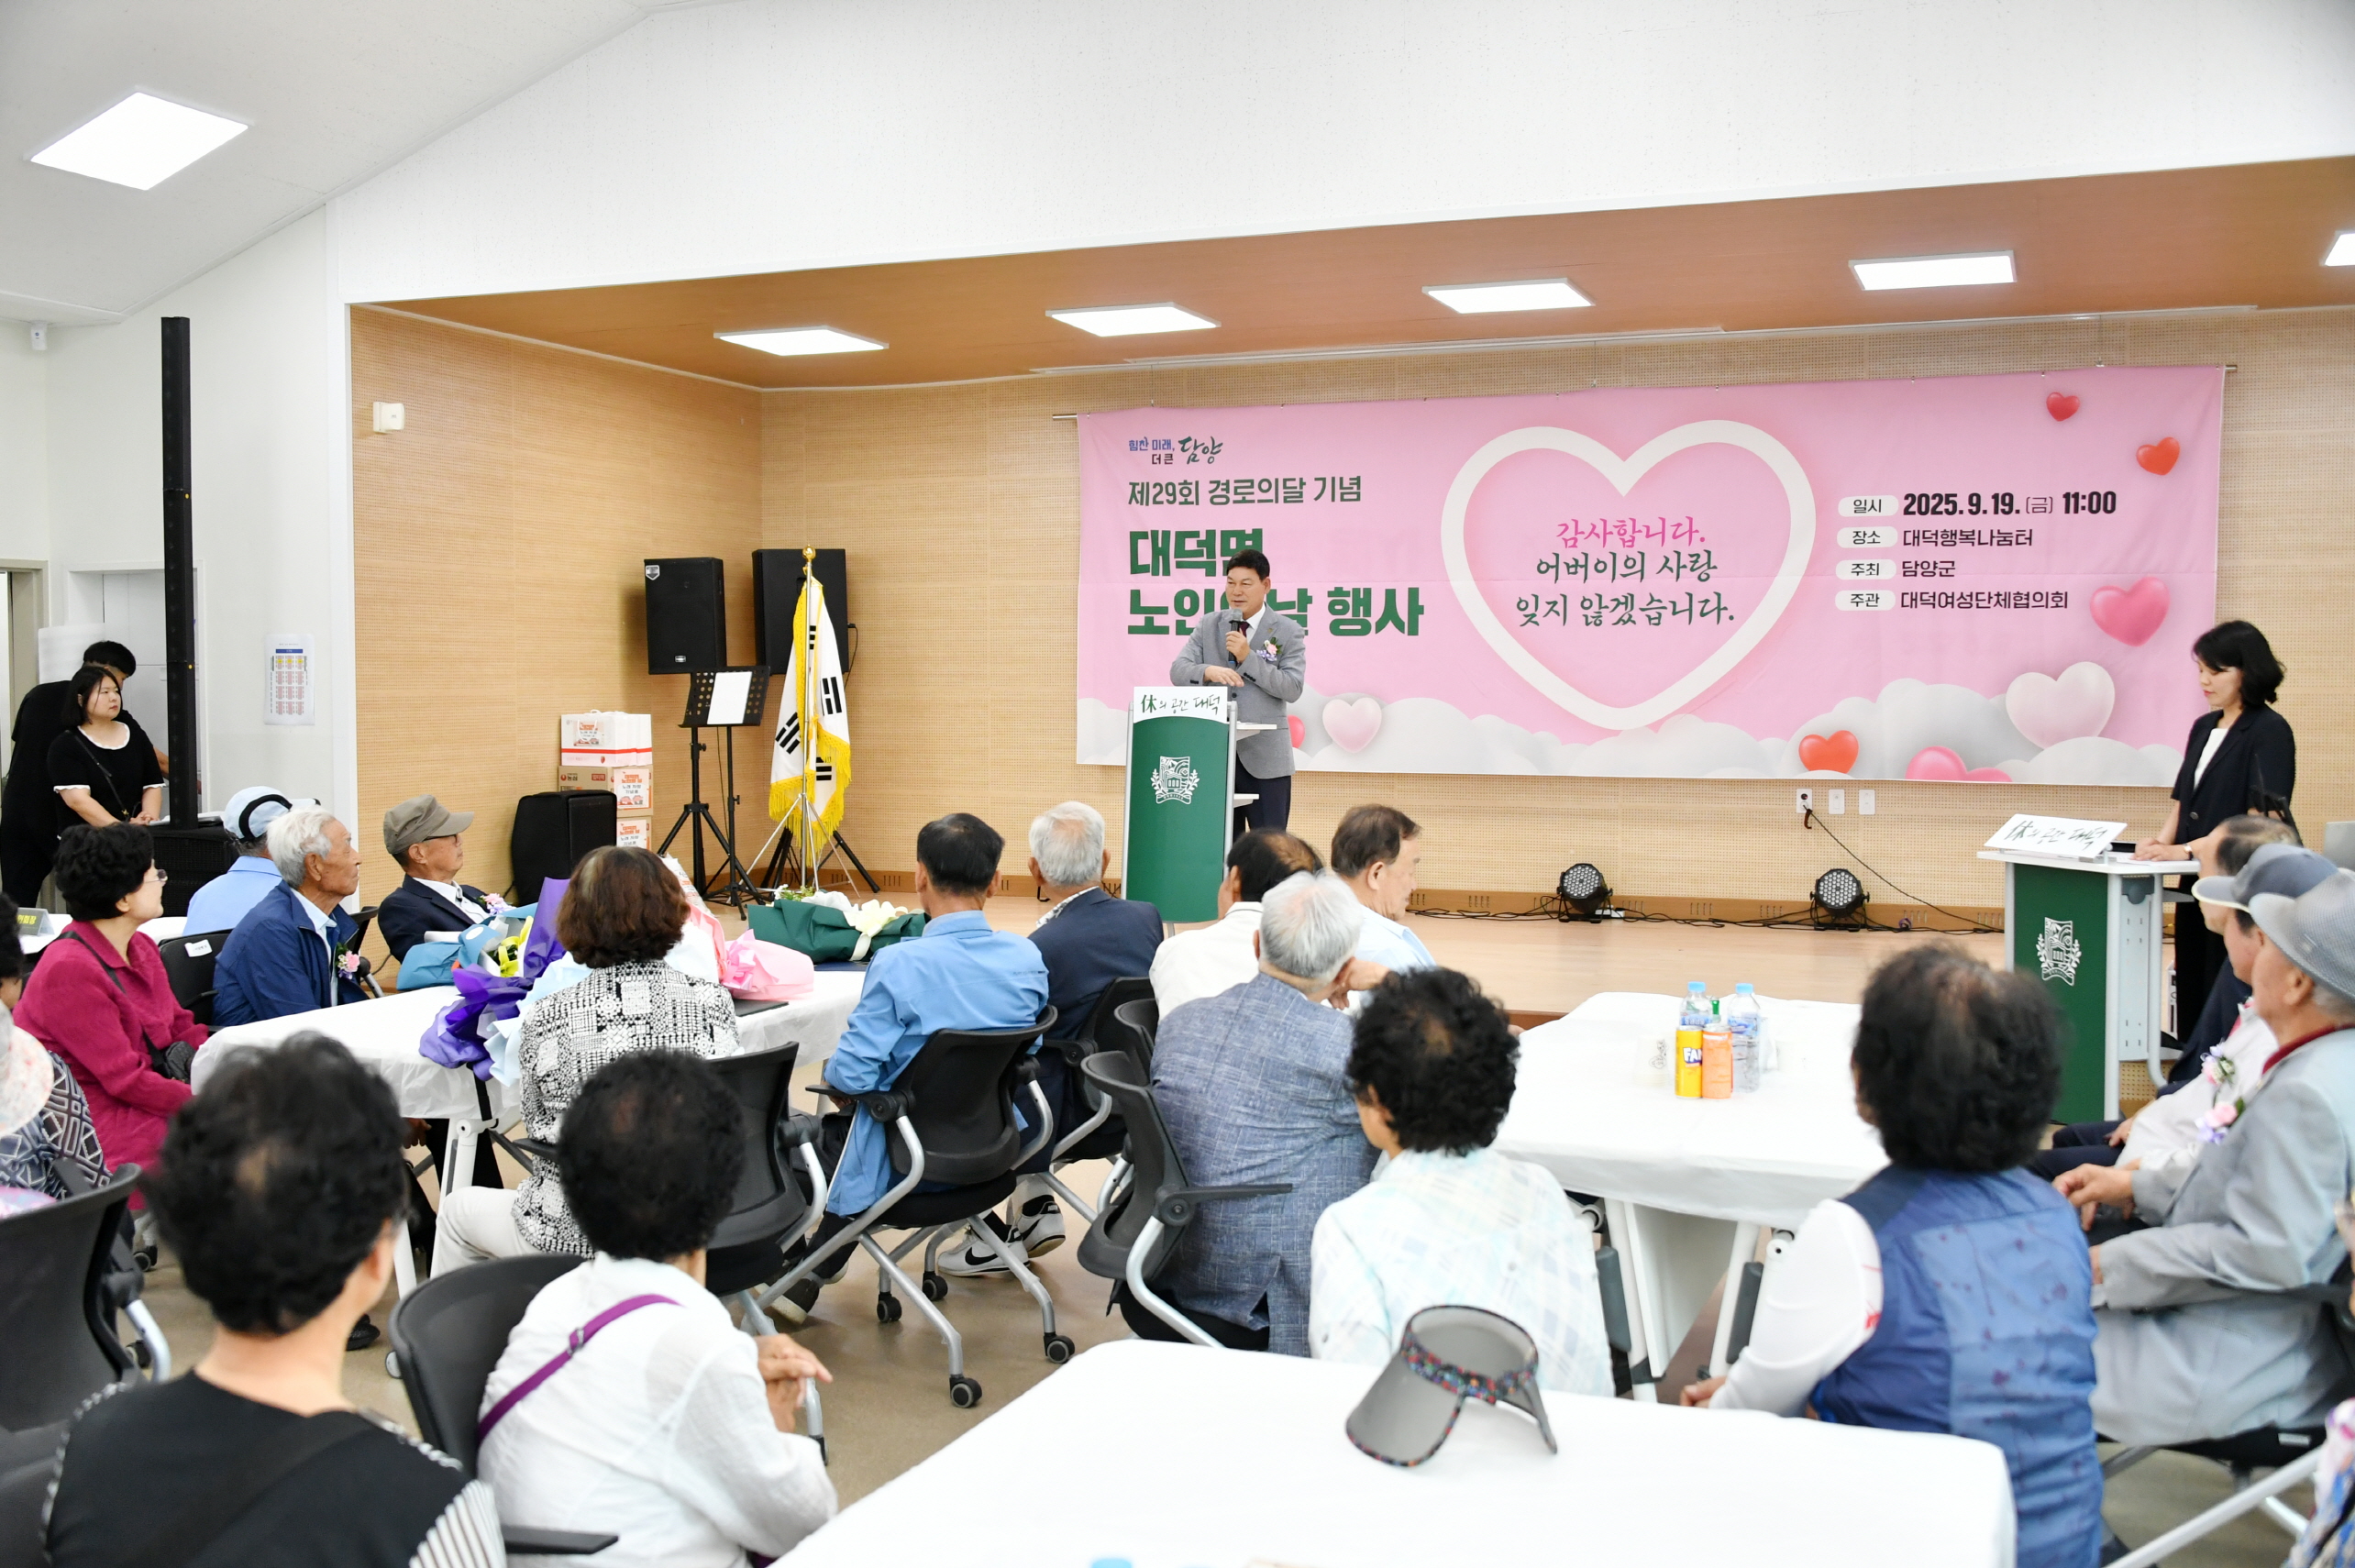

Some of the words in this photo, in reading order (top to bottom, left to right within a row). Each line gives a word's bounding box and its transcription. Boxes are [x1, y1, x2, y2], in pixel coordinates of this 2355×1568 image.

[1129, 437, 1149, 451] 힘찬
[1152, 439, 1175, 452] 미래,
[1178, 436, 1223, 464] 담양
[1152, 454, 1161, 465] 더
[1164, 454, 1174, 465] 큰
[1128, 480, 1200, 506] 제29회
[1209, 478, 1306, 506] 경로의달
[1314, 476, 1362, 502] 기념
[1852, 498, 1882, 514] 일시
[2062, 491, 2117, 514] 11:00
[1557, 516, 1706, 549] 감사합니다.
[1852, 530, 1882, 546] 장소
[1903, 529, 2033, 547] 대덕행복나눔터
[1536, 550, 1646, 584] 어버이의
[1655, 549, 1719, 583] 사랑
[1851, 562, 1880, 577] 주최
[1901, 559, 1956, 578] 담양군
[1127, 587, 1313, 637] 노인날
[1327, 587, 1425, 637] 행사
[1516, 592, 1568, 627] 잊지
[1579, 591, 1735, 627] 않겠습니다.
[1851, 592, 1881, 608] 주관
[1901, 591, 2069, 610] 대덕여성단체협의회
[1170, 699, 1189, 714] 공간
[1192, 694, 1221, 715] 대덕
